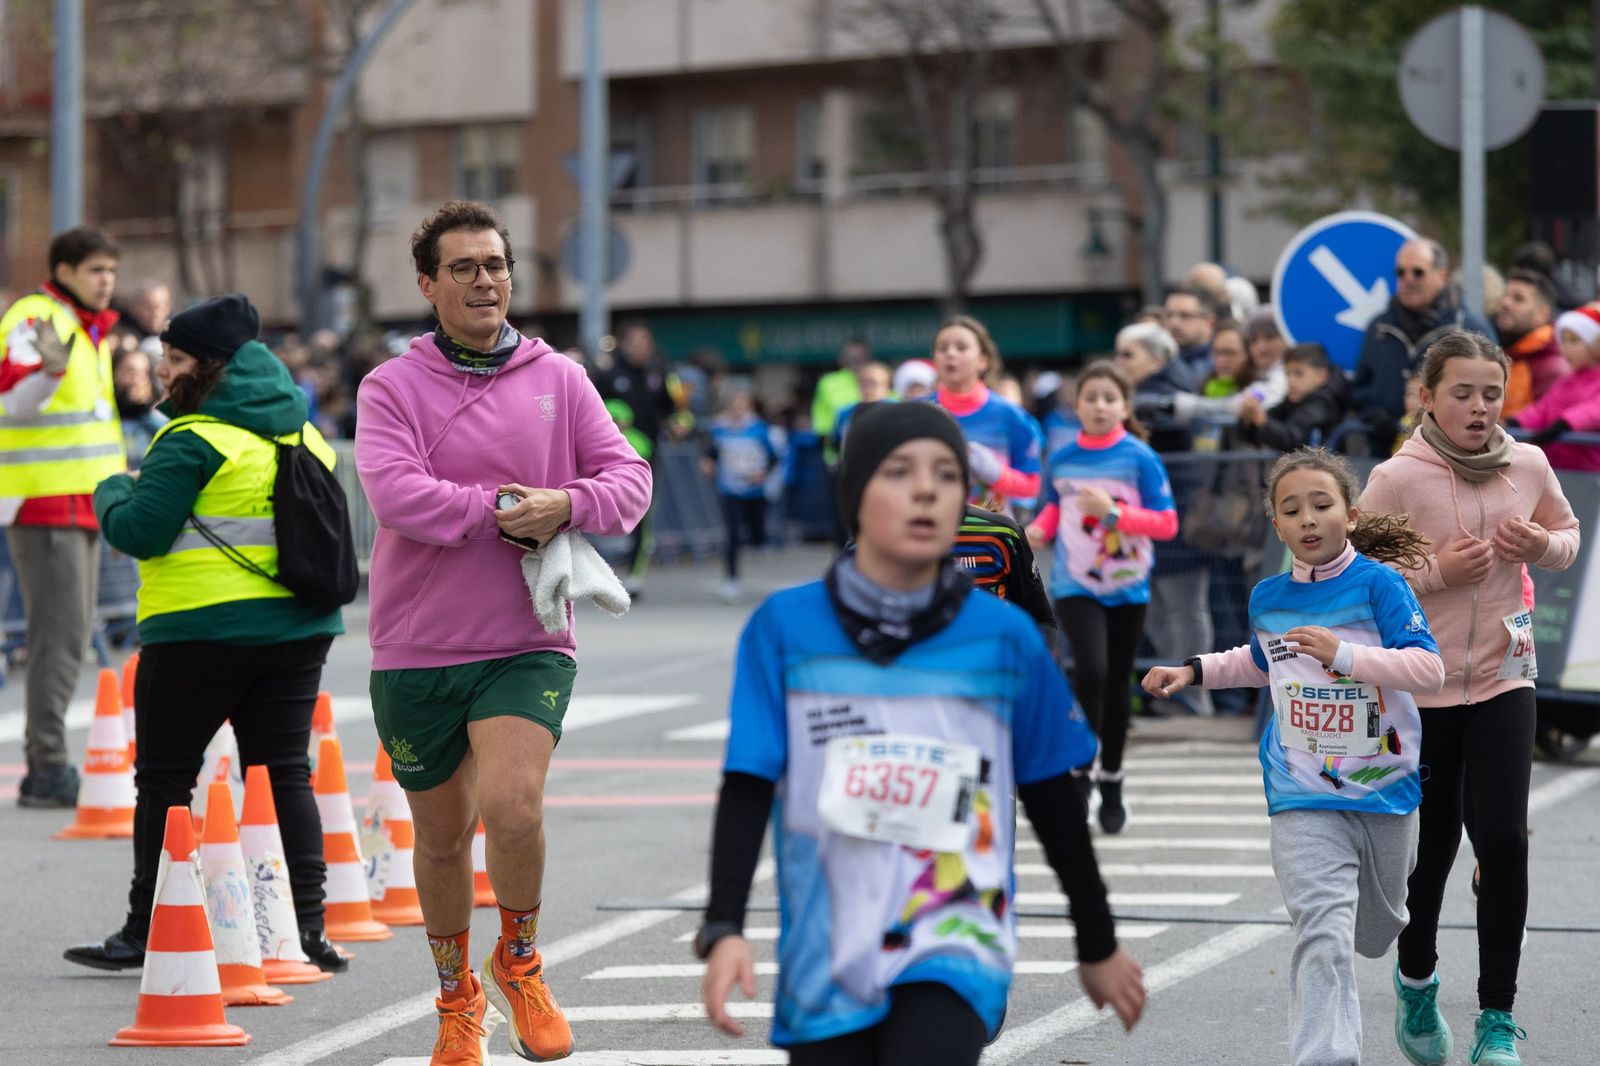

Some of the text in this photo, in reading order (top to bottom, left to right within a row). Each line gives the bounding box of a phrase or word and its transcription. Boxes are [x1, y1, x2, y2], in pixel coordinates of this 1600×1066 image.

[1514, 612, 1531, 628] SE
[1513, 631, 1535, 658] 64
[1302, 687, 1369, 700] SETEL
[1290, 699, 1354, 732] 6528
[845, 763, 940, 808] 6357
